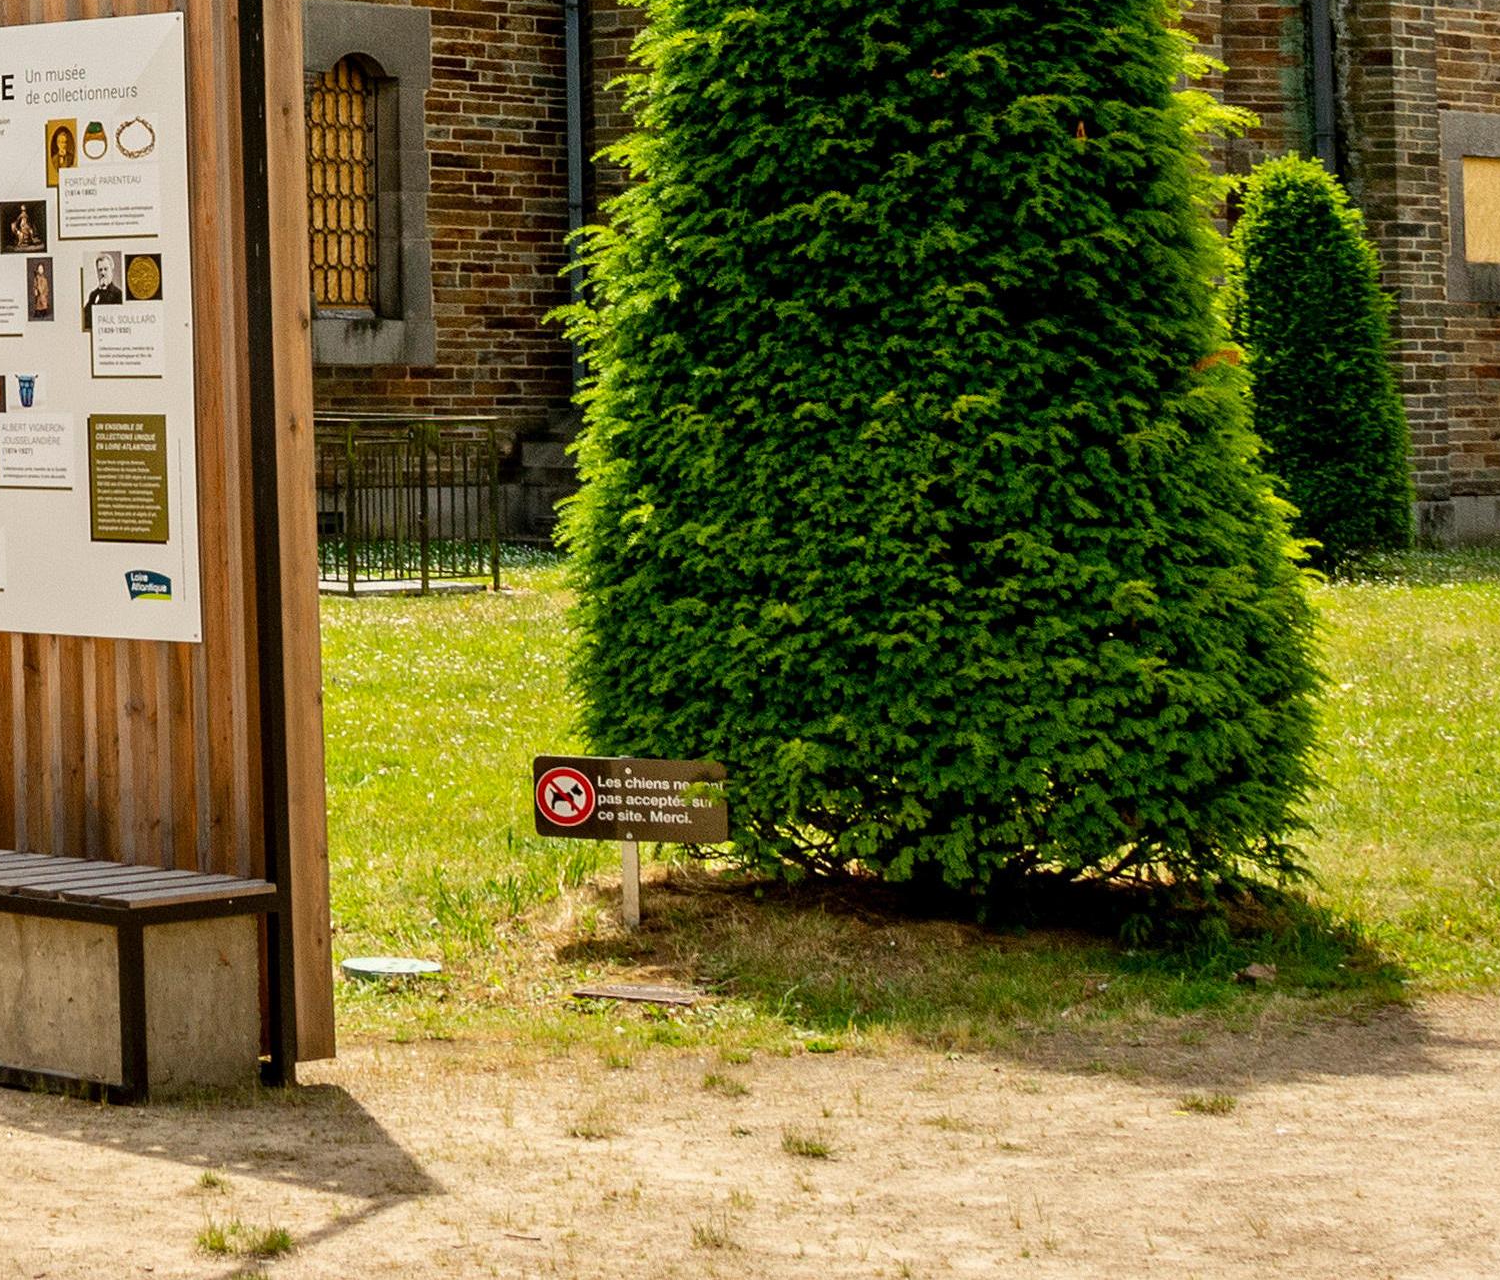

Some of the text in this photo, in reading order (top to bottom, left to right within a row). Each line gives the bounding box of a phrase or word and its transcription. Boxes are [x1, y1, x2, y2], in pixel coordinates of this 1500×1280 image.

[25, 64, 87, 84] Un musée
[25, 85, 139, 105] de collectionneurs
[99, 175, 142, 186] PARENTEAU
[97, 315, 116, 325] PAUL
[1, 422, 26, 432] ALBERT
[130, 572, 148, 583] Loire
[131, 583, 167, 594] Atlantique
[597, 776, 622, 789] Les
[624, 776, 670, 791] chiens
[597, 794, 623, 807] pas
[597, 809, 694, 824] ce site. Merci.
